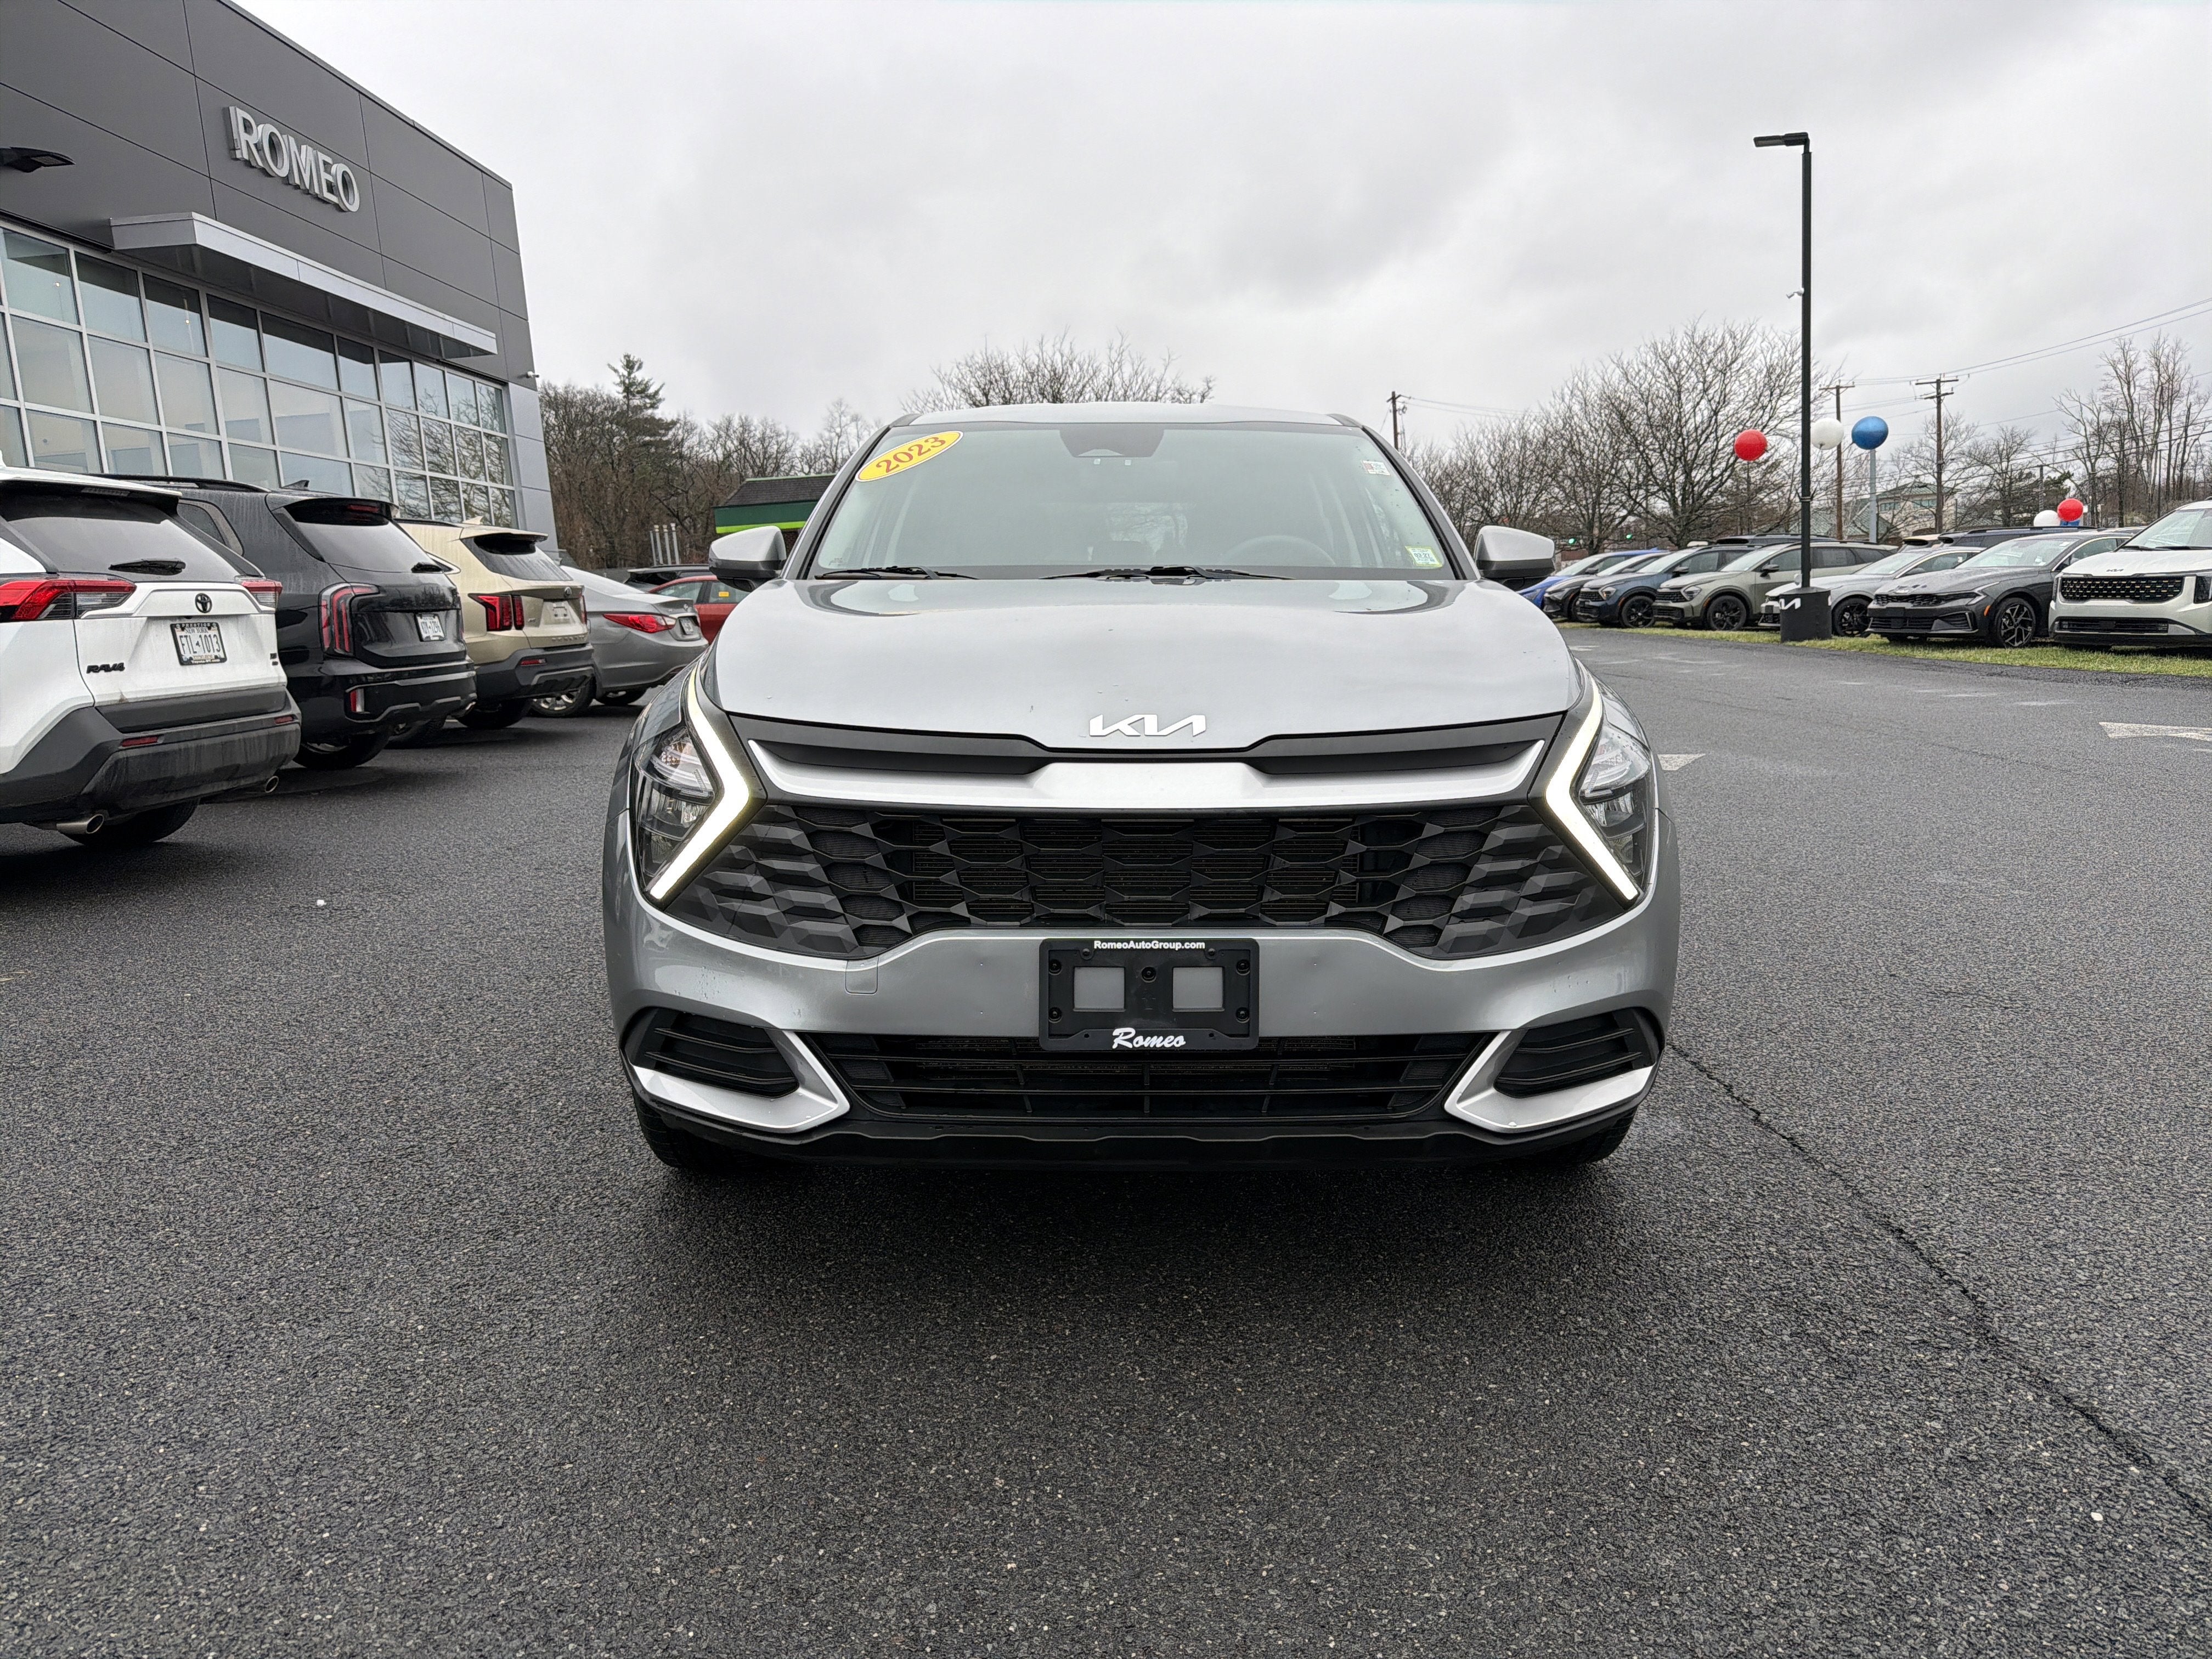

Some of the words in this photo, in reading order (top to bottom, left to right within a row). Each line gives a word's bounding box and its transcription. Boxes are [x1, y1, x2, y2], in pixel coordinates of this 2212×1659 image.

[229, 106, 360, 212] ROMEO
[876, 437, 945, 473] 2023
[199, 634, 221, 654] 1013
[86, 662, 125, 674] RAV4
[1090, 714, 1206, 737] KIA
[1094, 940, 1205, 950] RomeoAutoGroup.com
[1112, 1027, 1186, 1049] Romeo
